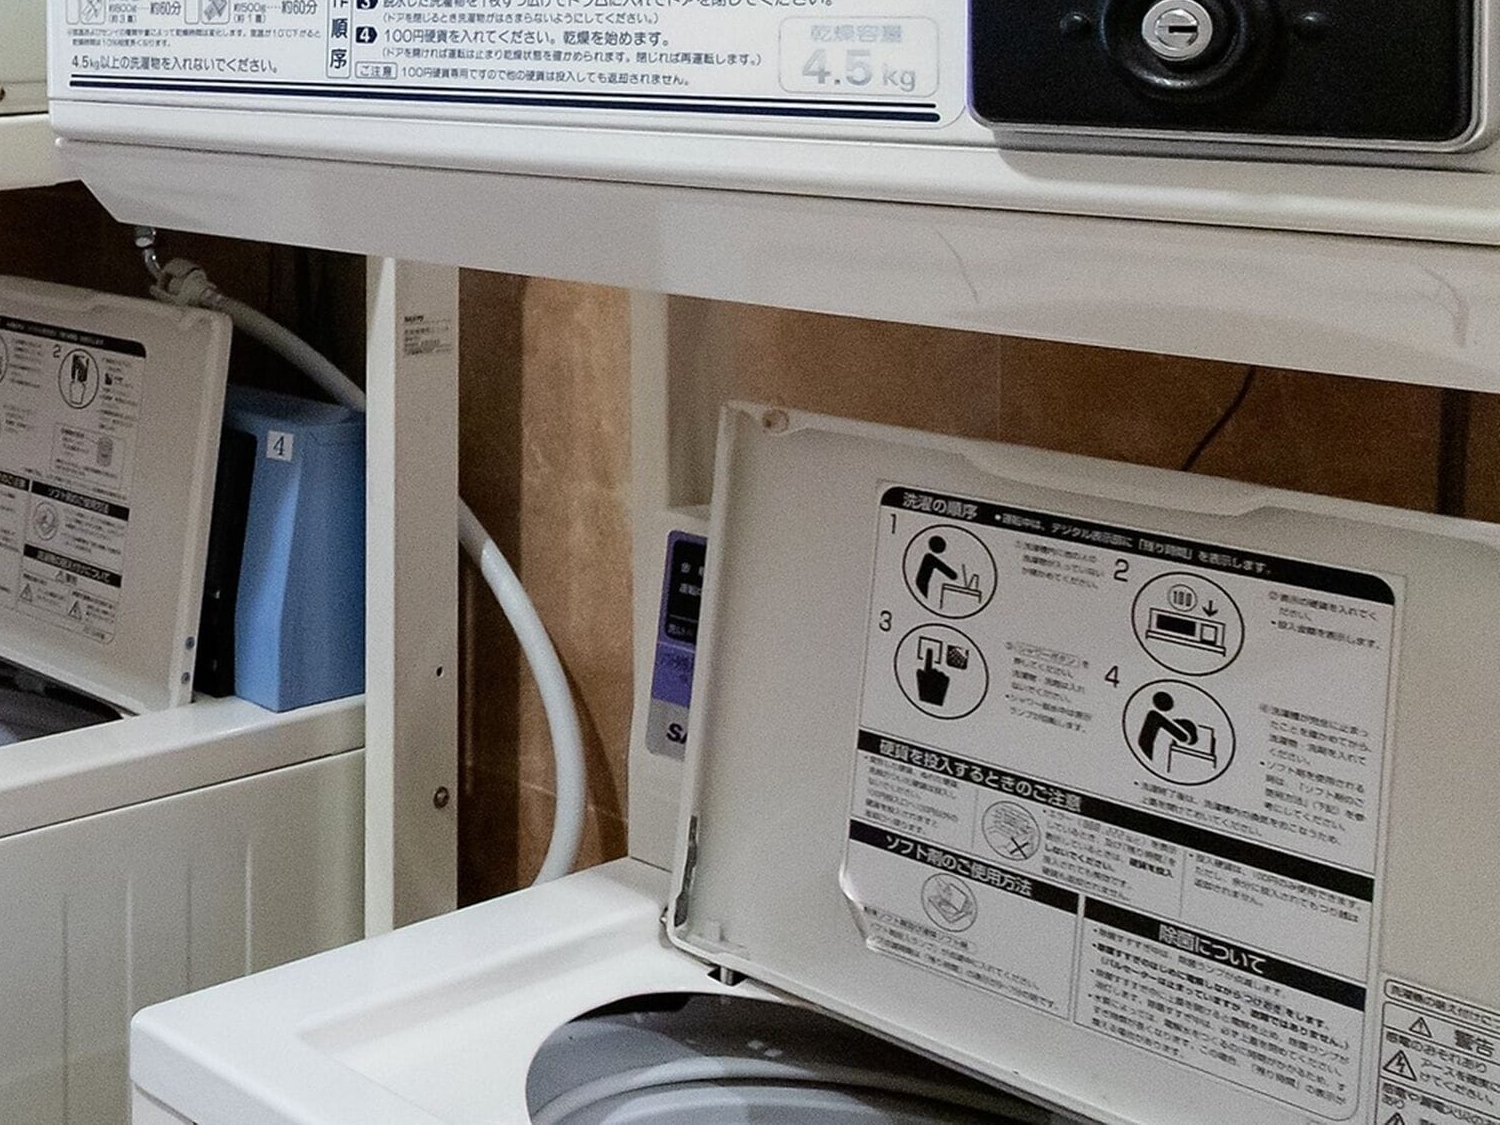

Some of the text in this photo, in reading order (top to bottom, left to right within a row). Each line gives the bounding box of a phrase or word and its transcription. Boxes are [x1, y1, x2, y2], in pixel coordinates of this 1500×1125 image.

[810, 25, 903, 43] 乾燥容量
[360, 65, 392, 77] ご注意
[802, 49, 916, 92] 4.5 kg
[53, 344, 62, 358] 2
[273, 436, 285, 457] 4
[902, 490, 978, 521] 洗濯の順序
[890, 513, 898, 535] 1
[1114, 558, 1130, 582] 2
[878, 610, 893, 632] 3
[1104, 665, 1120, 688] 4
[878, 738, 1083, 813] 硬貨を投入するときのご注意
[885, 834, 1033, 896] ソフト剤のご使用方法
[1159, 924, 1267, 974] 除菌について
